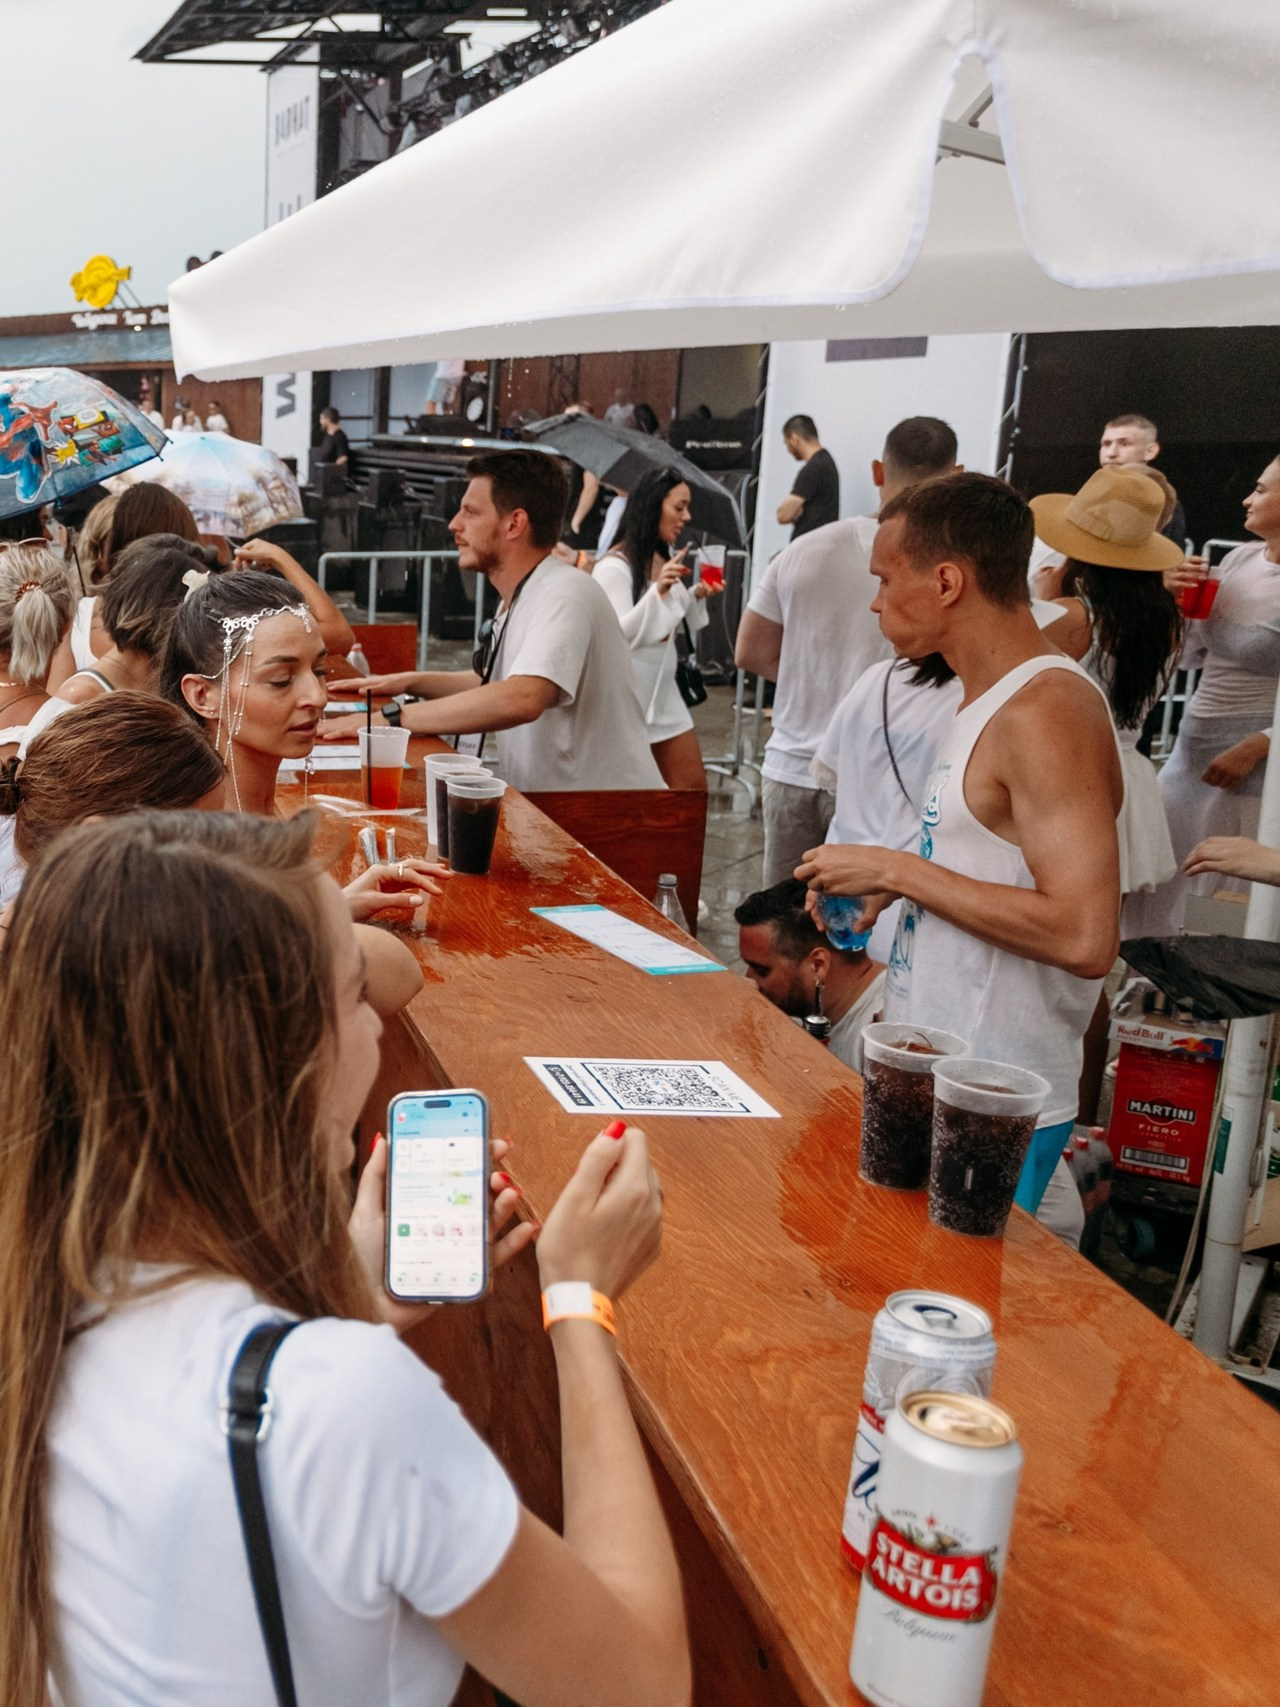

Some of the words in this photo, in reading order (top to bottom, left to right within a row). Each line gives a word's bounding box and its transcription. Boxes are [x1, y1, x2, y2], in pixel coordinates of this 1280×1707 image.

[1141, 1028, 1165, 1042] Bull
[1129, 1100, 1195, 1121] MARTINI
[1138, 1123, 1180, 1136] FIERO
[876, 1531, 982, 1587] STELLA
[872, 1553, 980, 1611] ARTOIS
